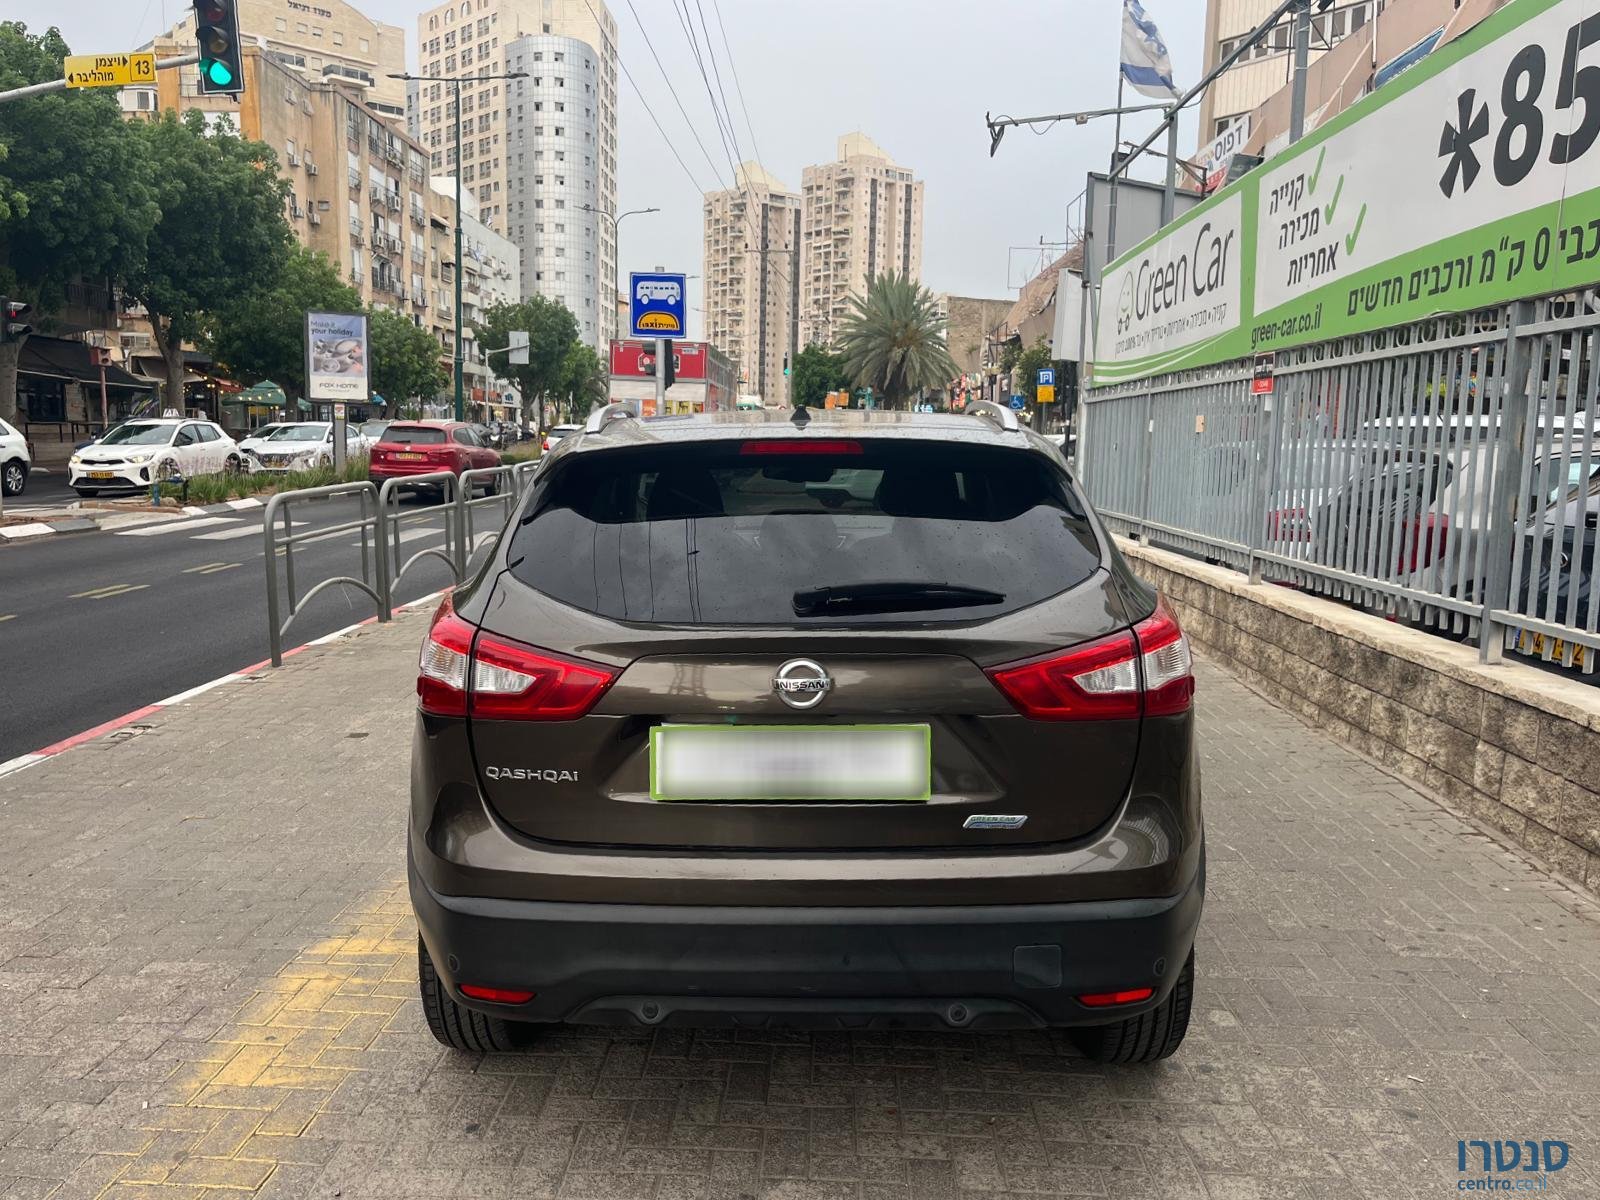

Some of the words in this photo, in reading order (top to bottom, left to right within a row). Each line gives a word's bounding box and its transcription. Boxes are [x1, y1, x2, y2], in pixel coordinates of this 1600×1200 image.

[76, 70, 114, 83] מוהליבר
[95, 57, 121, 71] ויצמן
[135, 59, 150, 75] 13
[1214, 124, 1243, 161] דפוס
[1269, 172, 1305, 216] קנייה
[1278, 207, 1320, 251] מכירה
[1532, 226, 1551, 272] 0
[1135, 253, 1188, 321] Green
[1192, 221, 1235, 297] Car
[1287, 240, 1340, 287] אחריות
[1407, 255, 1474, 302] ורכבים
[1347, 275, 1404, 317] חדשים
[328, 328, 354, 337] holiday
[1251, 302, 1323, 350] green-car.co.il
[779, 681, 825, 689] NISSAN
